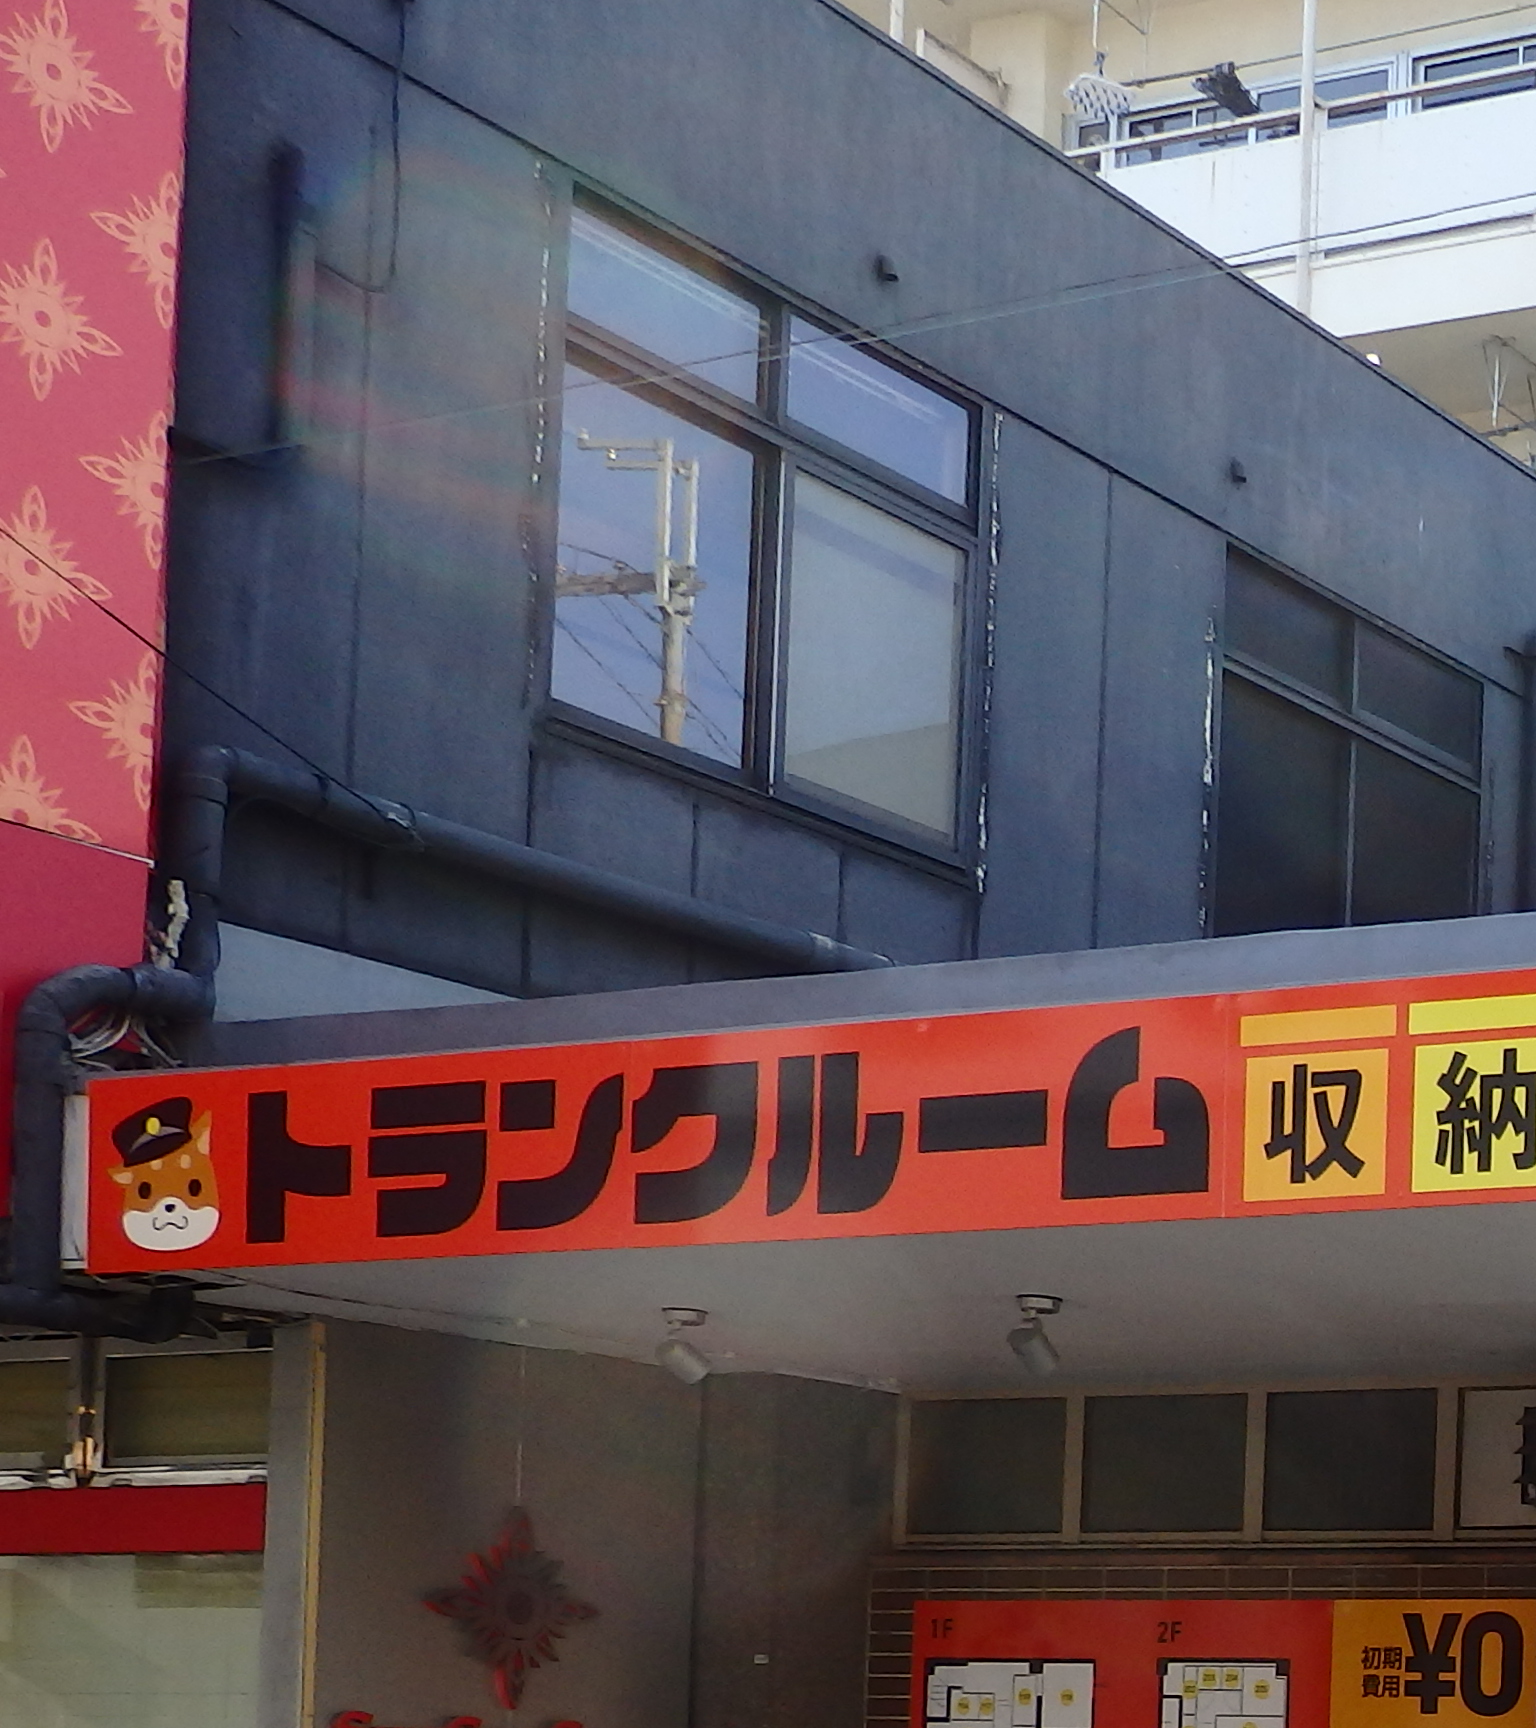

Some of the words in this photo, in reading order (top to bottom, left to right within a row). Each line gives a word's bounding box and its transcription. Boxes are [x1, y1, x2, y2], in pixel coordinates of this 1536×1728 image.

[246, 1026, 1212, 1245] トランクルーム
[930, 1618, 954, 1639] 1F
[1157, 1621, 1182, 1643] 2F
[1361, 1646, 1402, 1670] 初期
[1361, 1674, 1400, 1698] 費用
